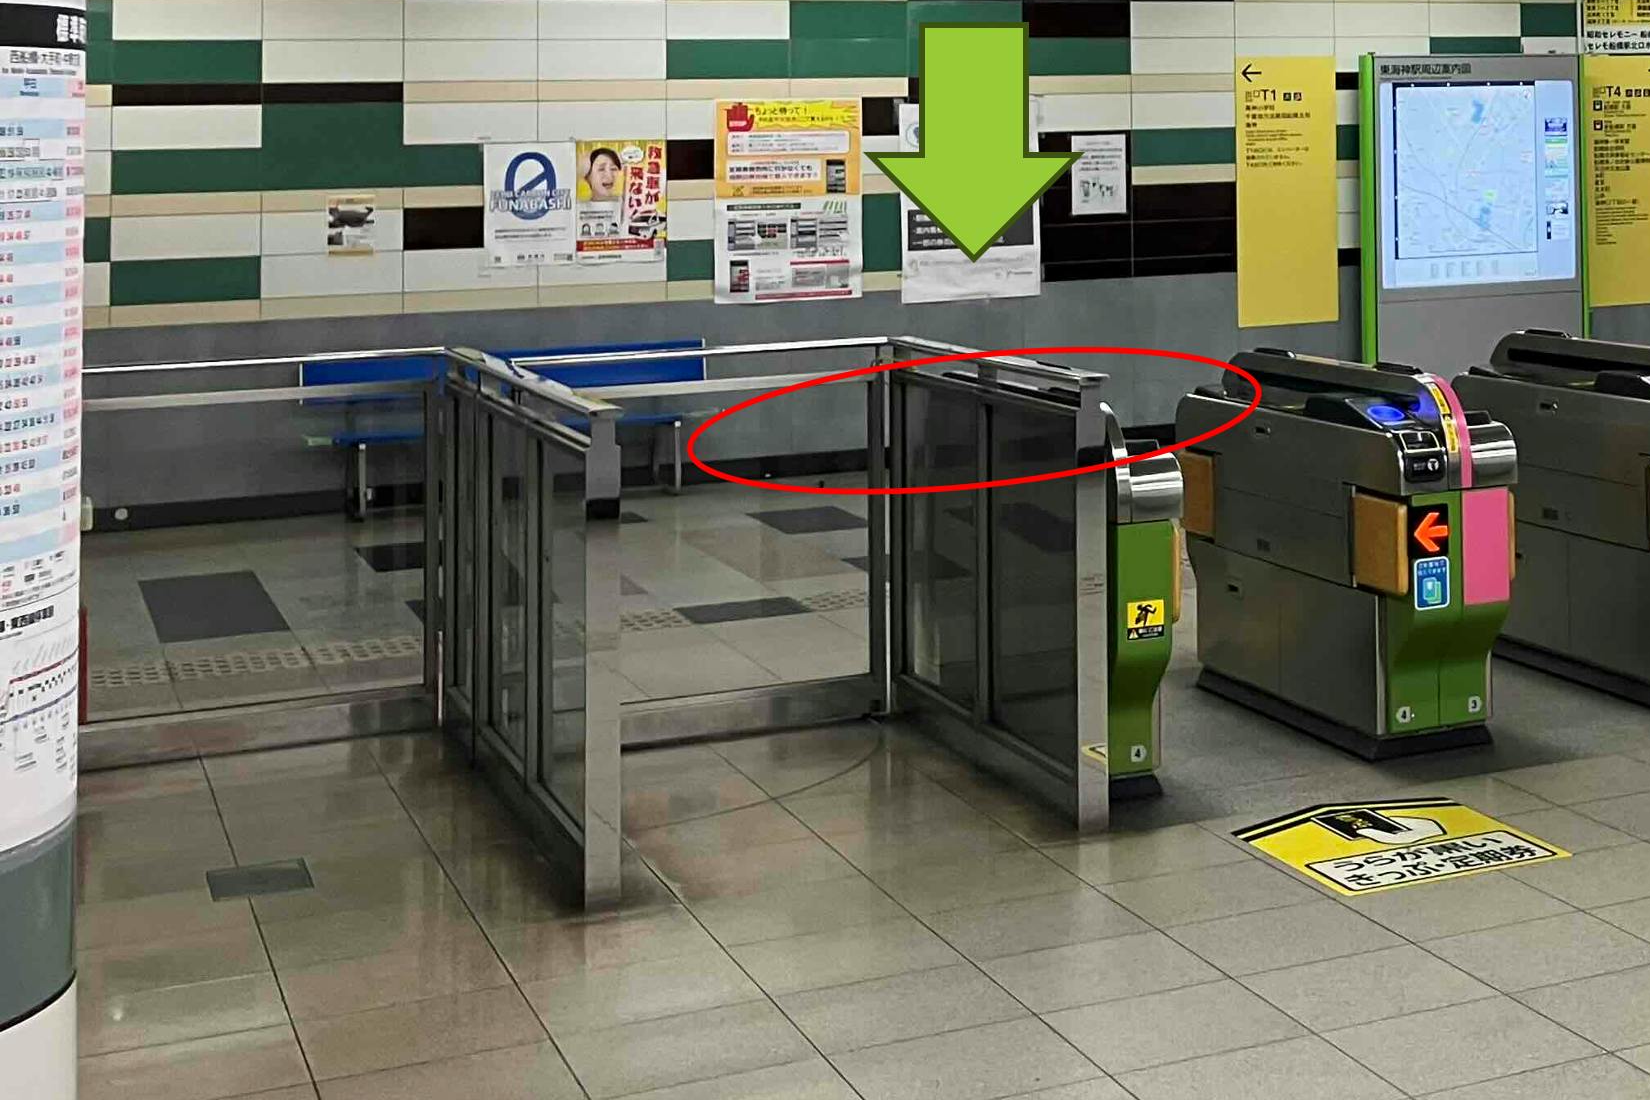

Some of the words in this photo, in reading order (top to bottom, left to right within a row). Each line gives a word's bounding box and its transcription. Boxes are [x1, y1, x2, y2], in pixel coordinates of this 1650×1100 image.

[1260, 89, 1276, 102] T1
[1606, 85, 1621, 98] T4
[489, 197, 572, 213] FUNABASHI
[1134, 748, 1141, 758] 4
[1334, 836, 1503, 872] うらが黒い
[1344, 844, 1538, 887] きっぷ・定期券
